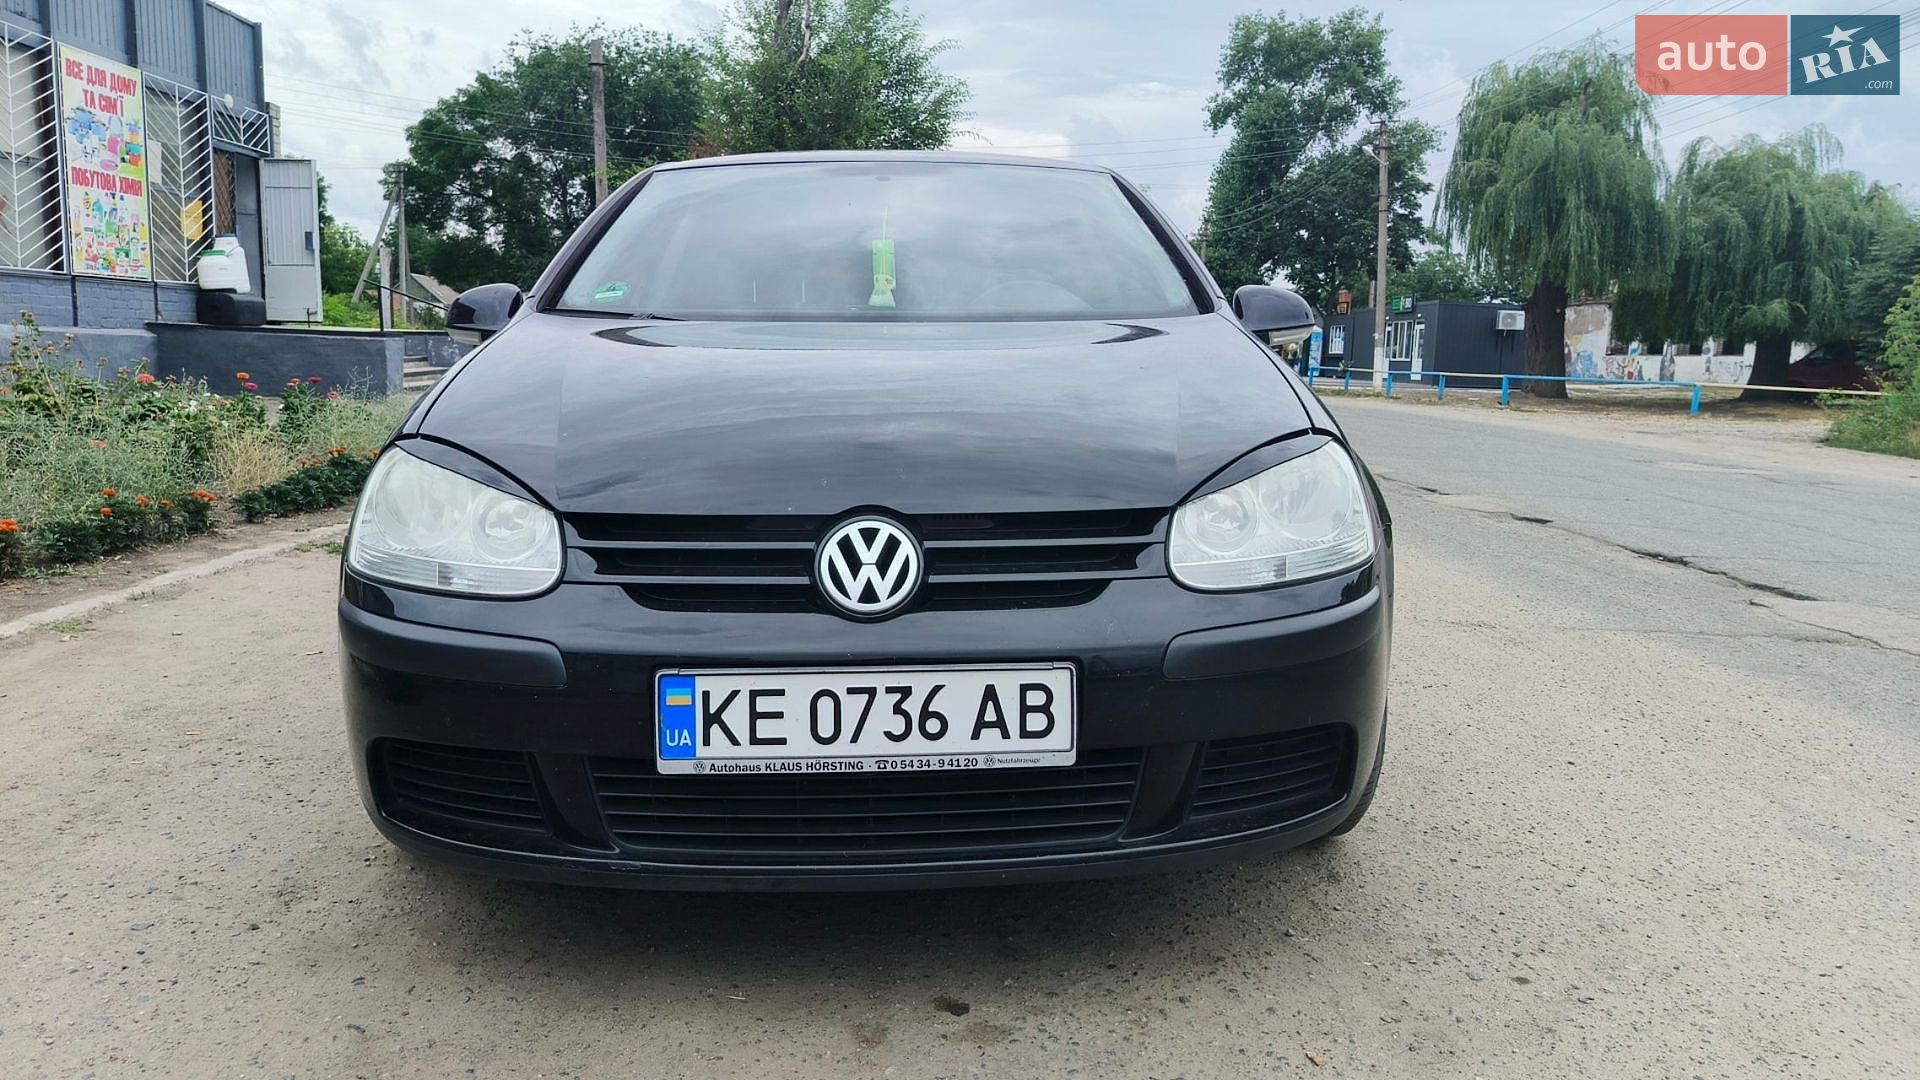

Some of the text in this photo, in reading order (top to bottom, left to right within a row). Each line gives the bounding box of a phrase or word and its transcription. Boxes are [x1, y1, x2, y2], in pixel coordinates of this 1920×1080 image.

[65, 57, 137, 97] ВСЕ ДЛЯ ДОМУ
[82, 89, 96, 109] ТА
[71, 166, 143, 197] ПОБУТОВА ХІМІЯ
[702, 683, 1055, 746] KE 0736 AB
[666, 729, 692, 746] UA
[709, 762, 762, 773] Autohaus
[765, 761, 802, 772] KLAUS
[805, 759, 864, 771] HÖRSTING
